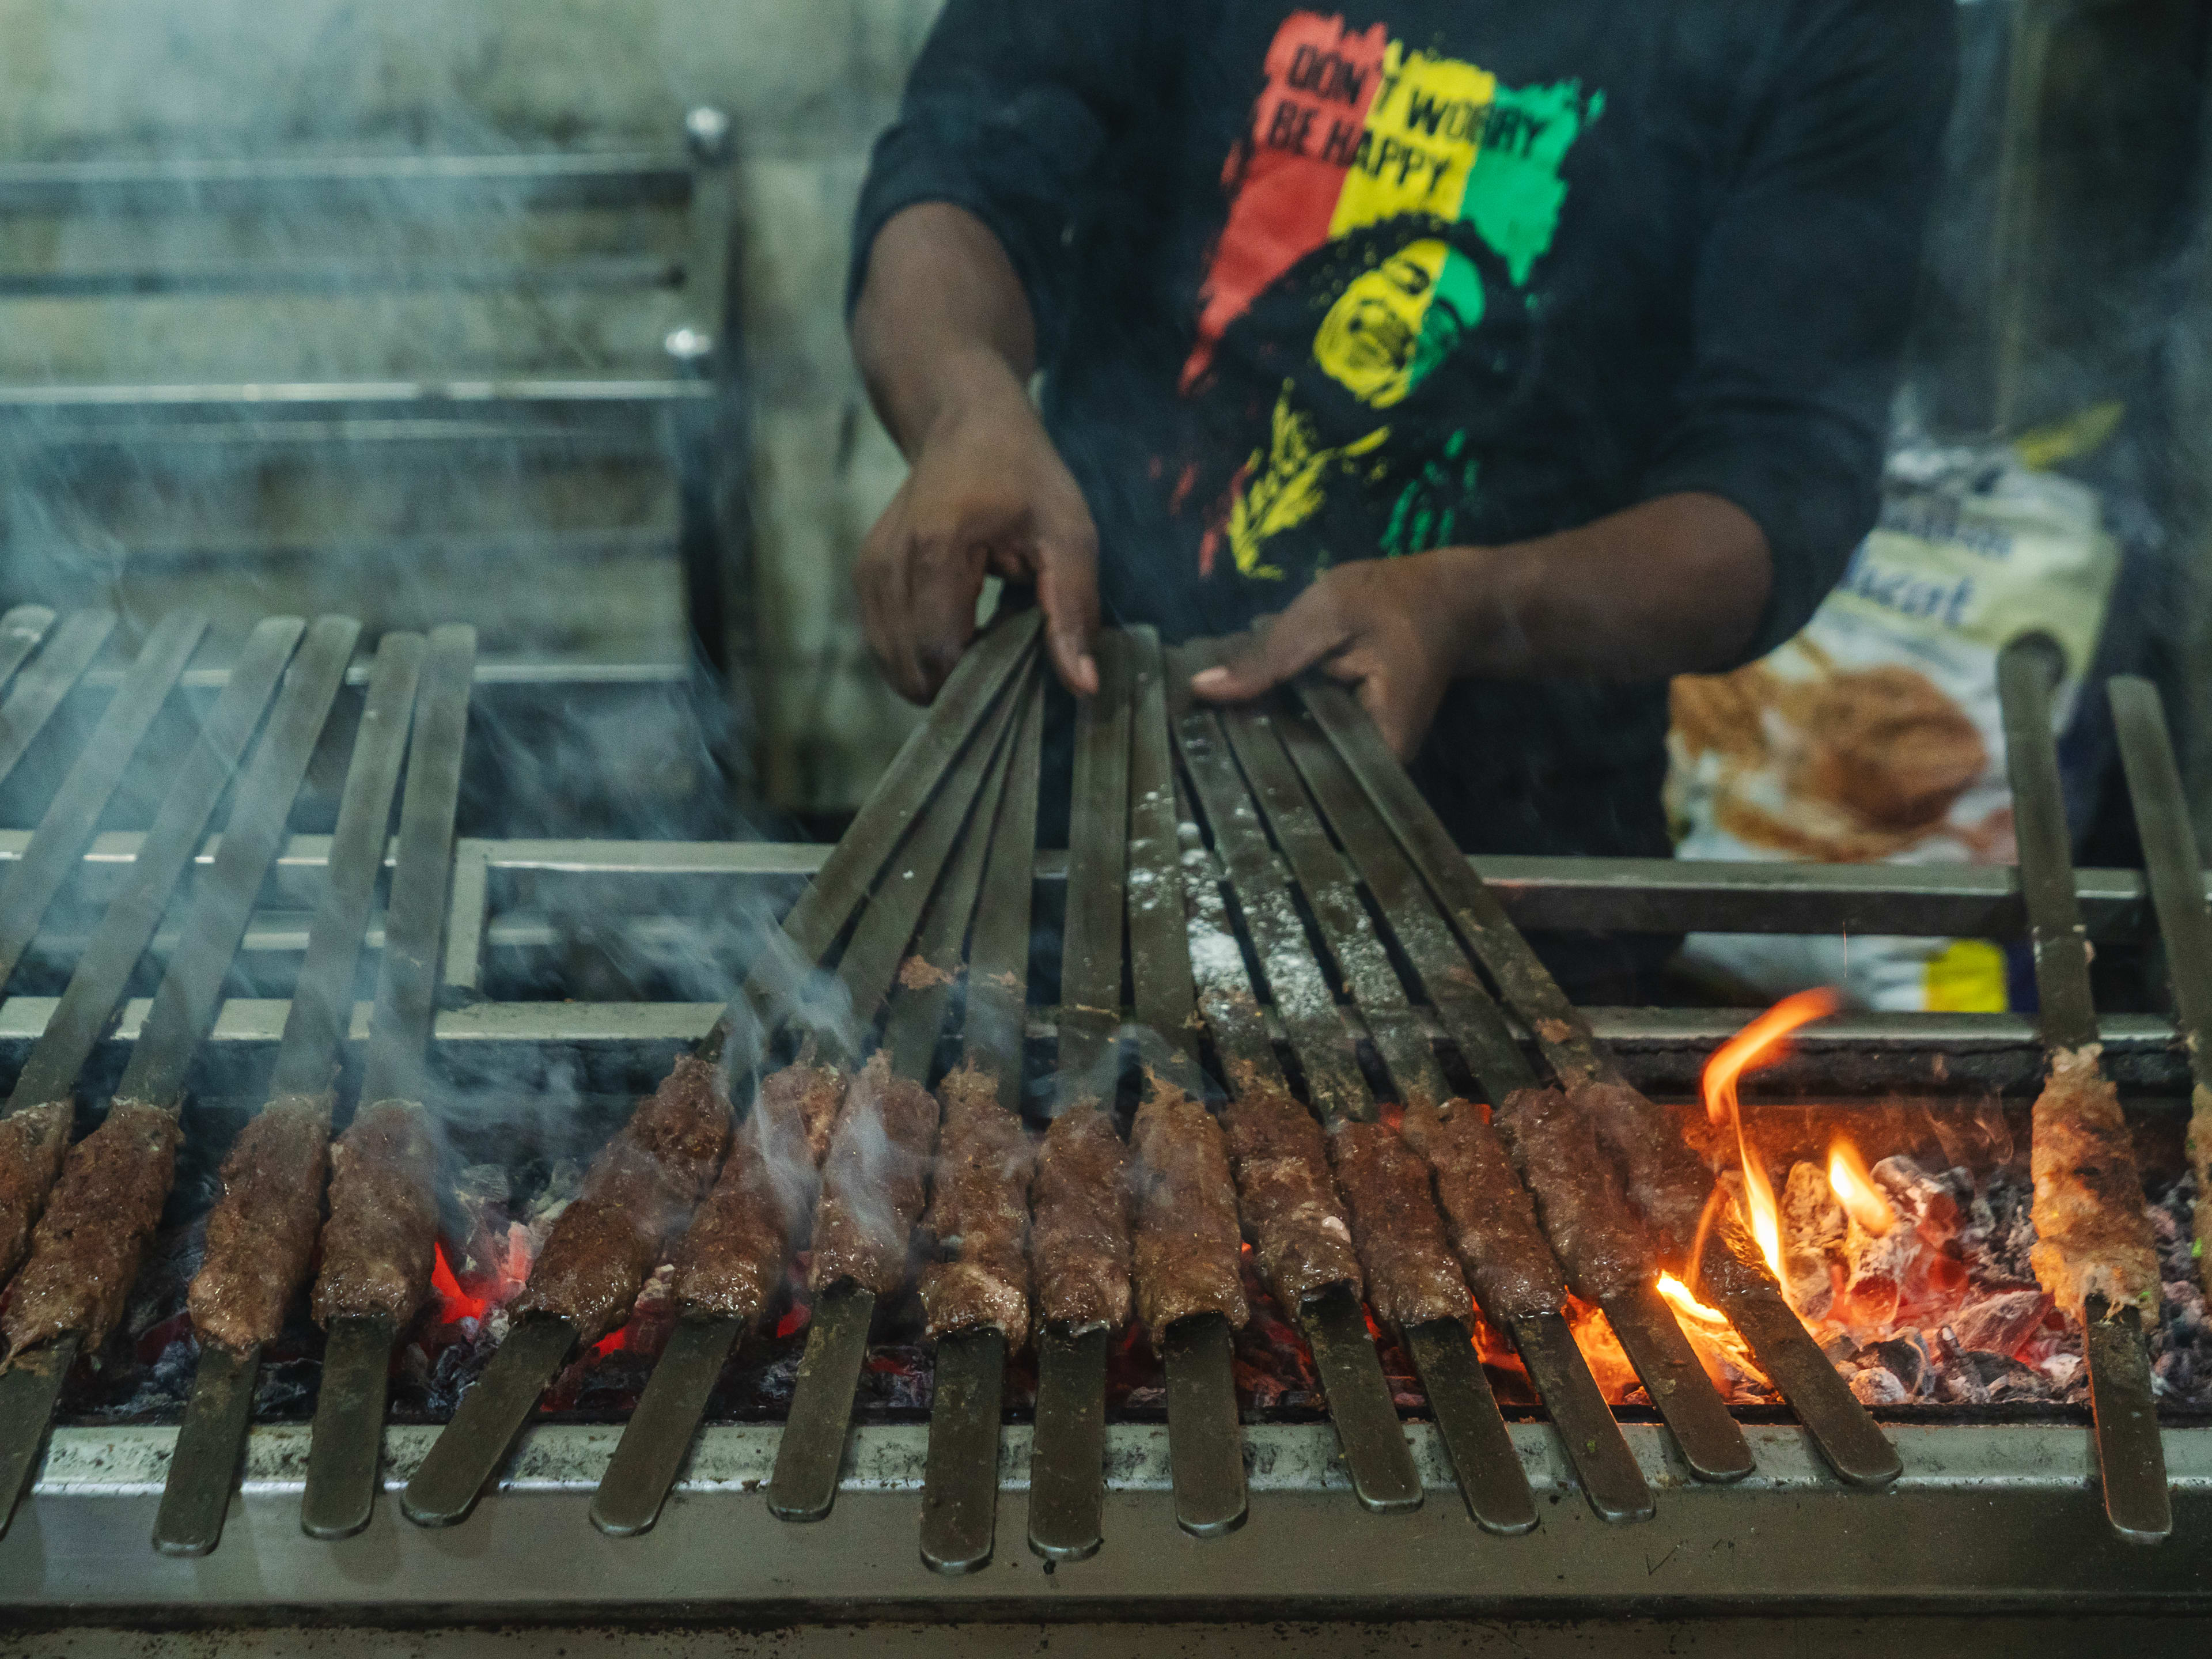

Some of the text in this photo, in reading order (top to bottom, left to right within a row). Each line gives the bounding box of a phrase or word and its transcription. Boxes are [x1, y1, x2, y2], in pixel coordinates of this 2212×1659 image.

[1269, 99, 1452, 194] BE HAPPY
[1287, 44, 1548, 158] DON'T WORRY
